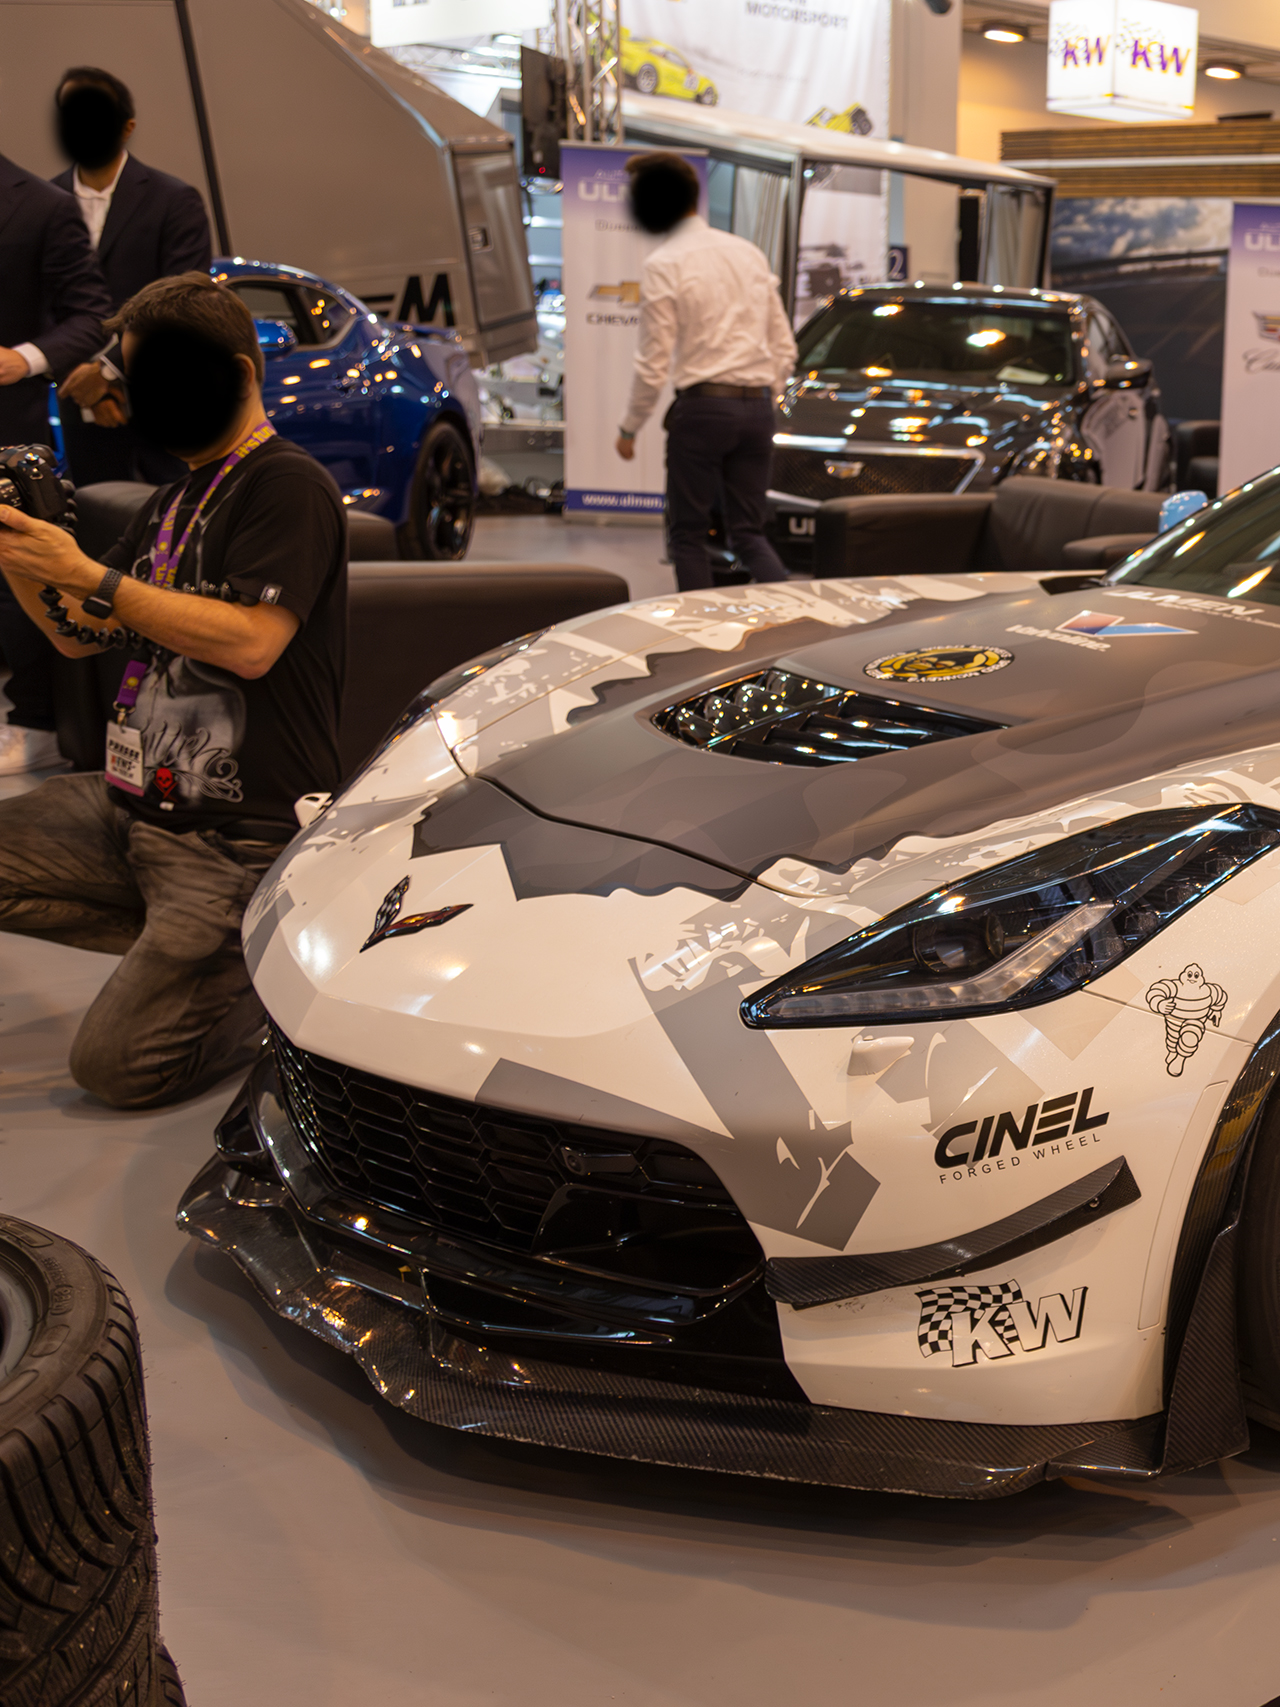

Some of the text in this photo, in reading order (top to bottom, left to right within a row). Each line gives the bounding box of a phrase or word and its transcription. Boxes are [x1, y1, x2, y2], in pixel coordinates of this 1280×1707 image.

[1131, 38, 1191, 77] KW
[934, 1086, 1110, 1169] CINEL
[939, 1132, 1101, 1184] FORGED WHEEL
[950, 1286, 1089, 1368] KW
